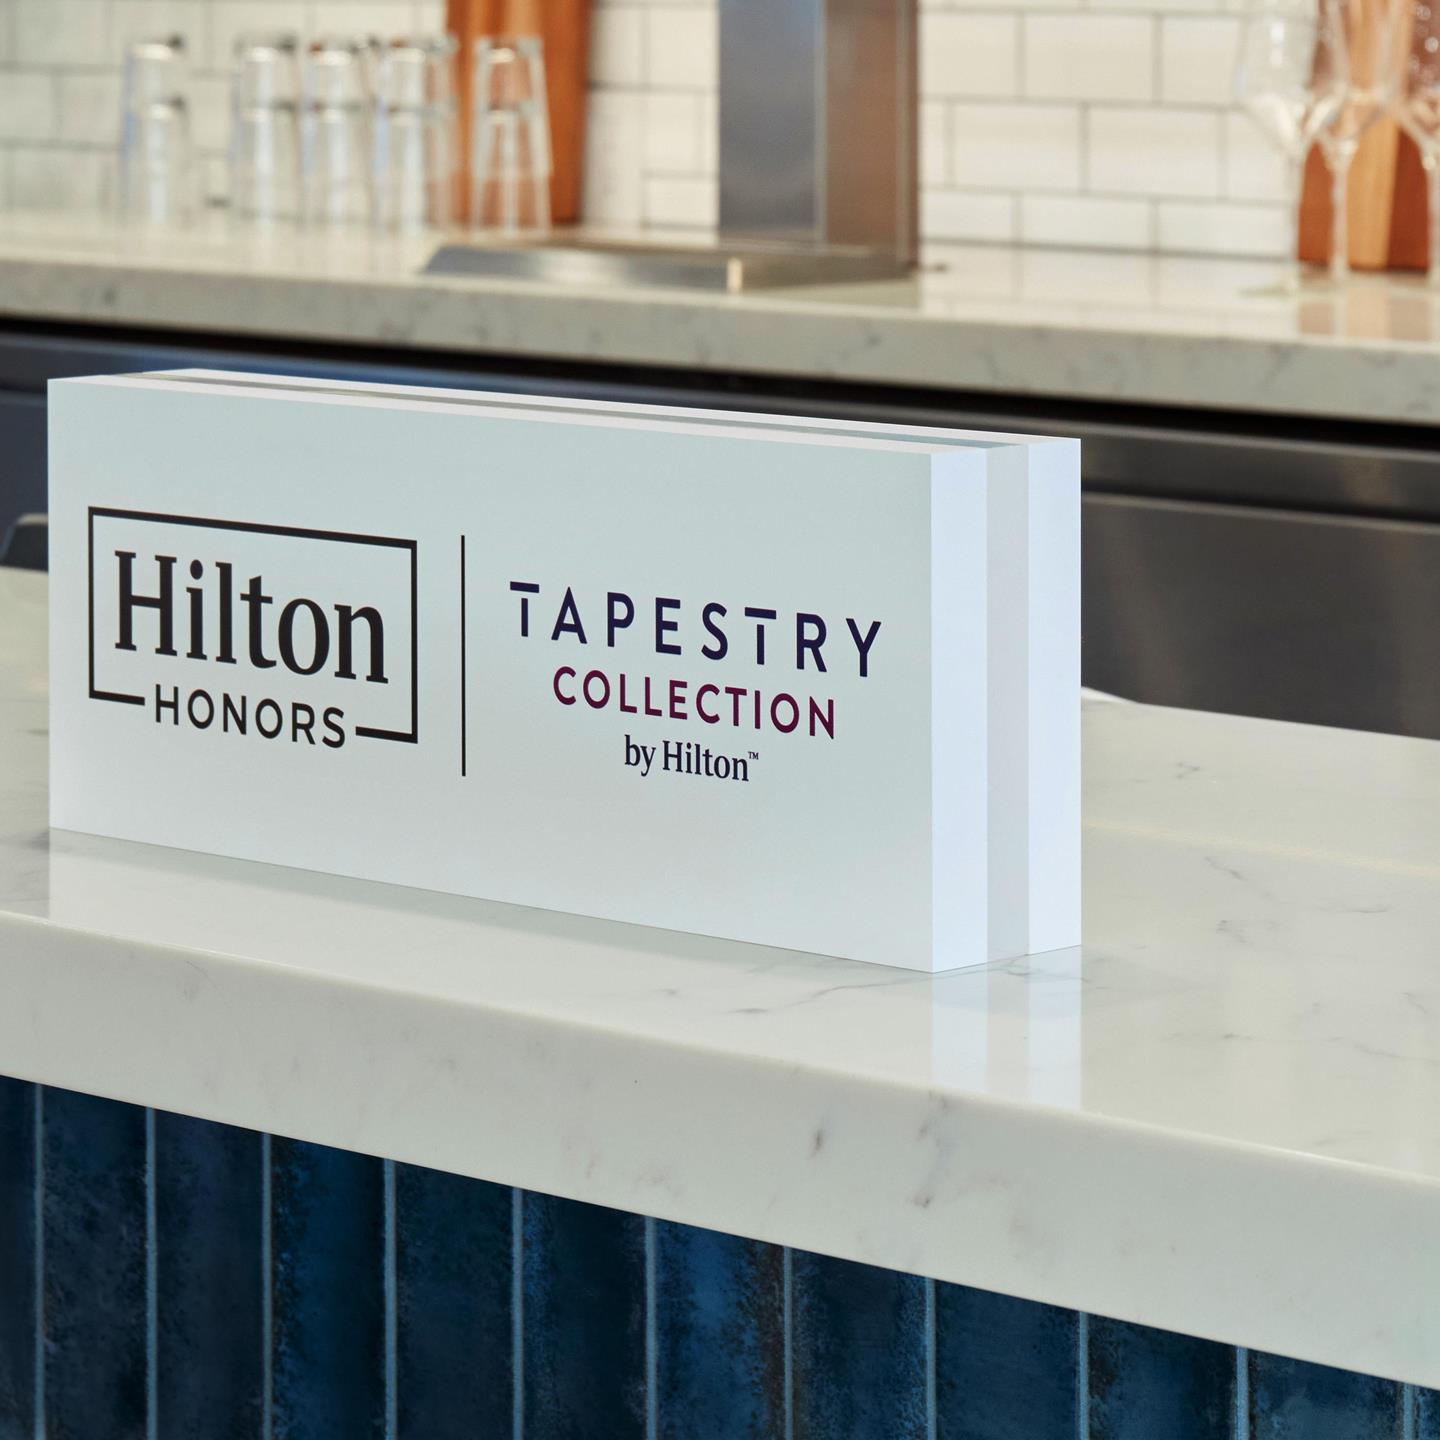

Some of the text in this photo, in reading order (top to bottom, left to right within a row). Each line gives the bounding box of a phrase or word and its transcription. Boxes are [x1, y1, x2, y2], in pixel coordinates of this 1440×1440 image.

[114, 549, 389, 685] Hilton
[509, 580, 882, 678] TAPESTRY
[155, 683, 346, 749] HONORS
[552, 665, 835, 740] COLLECTION
[624, 733, 657, 777] by
